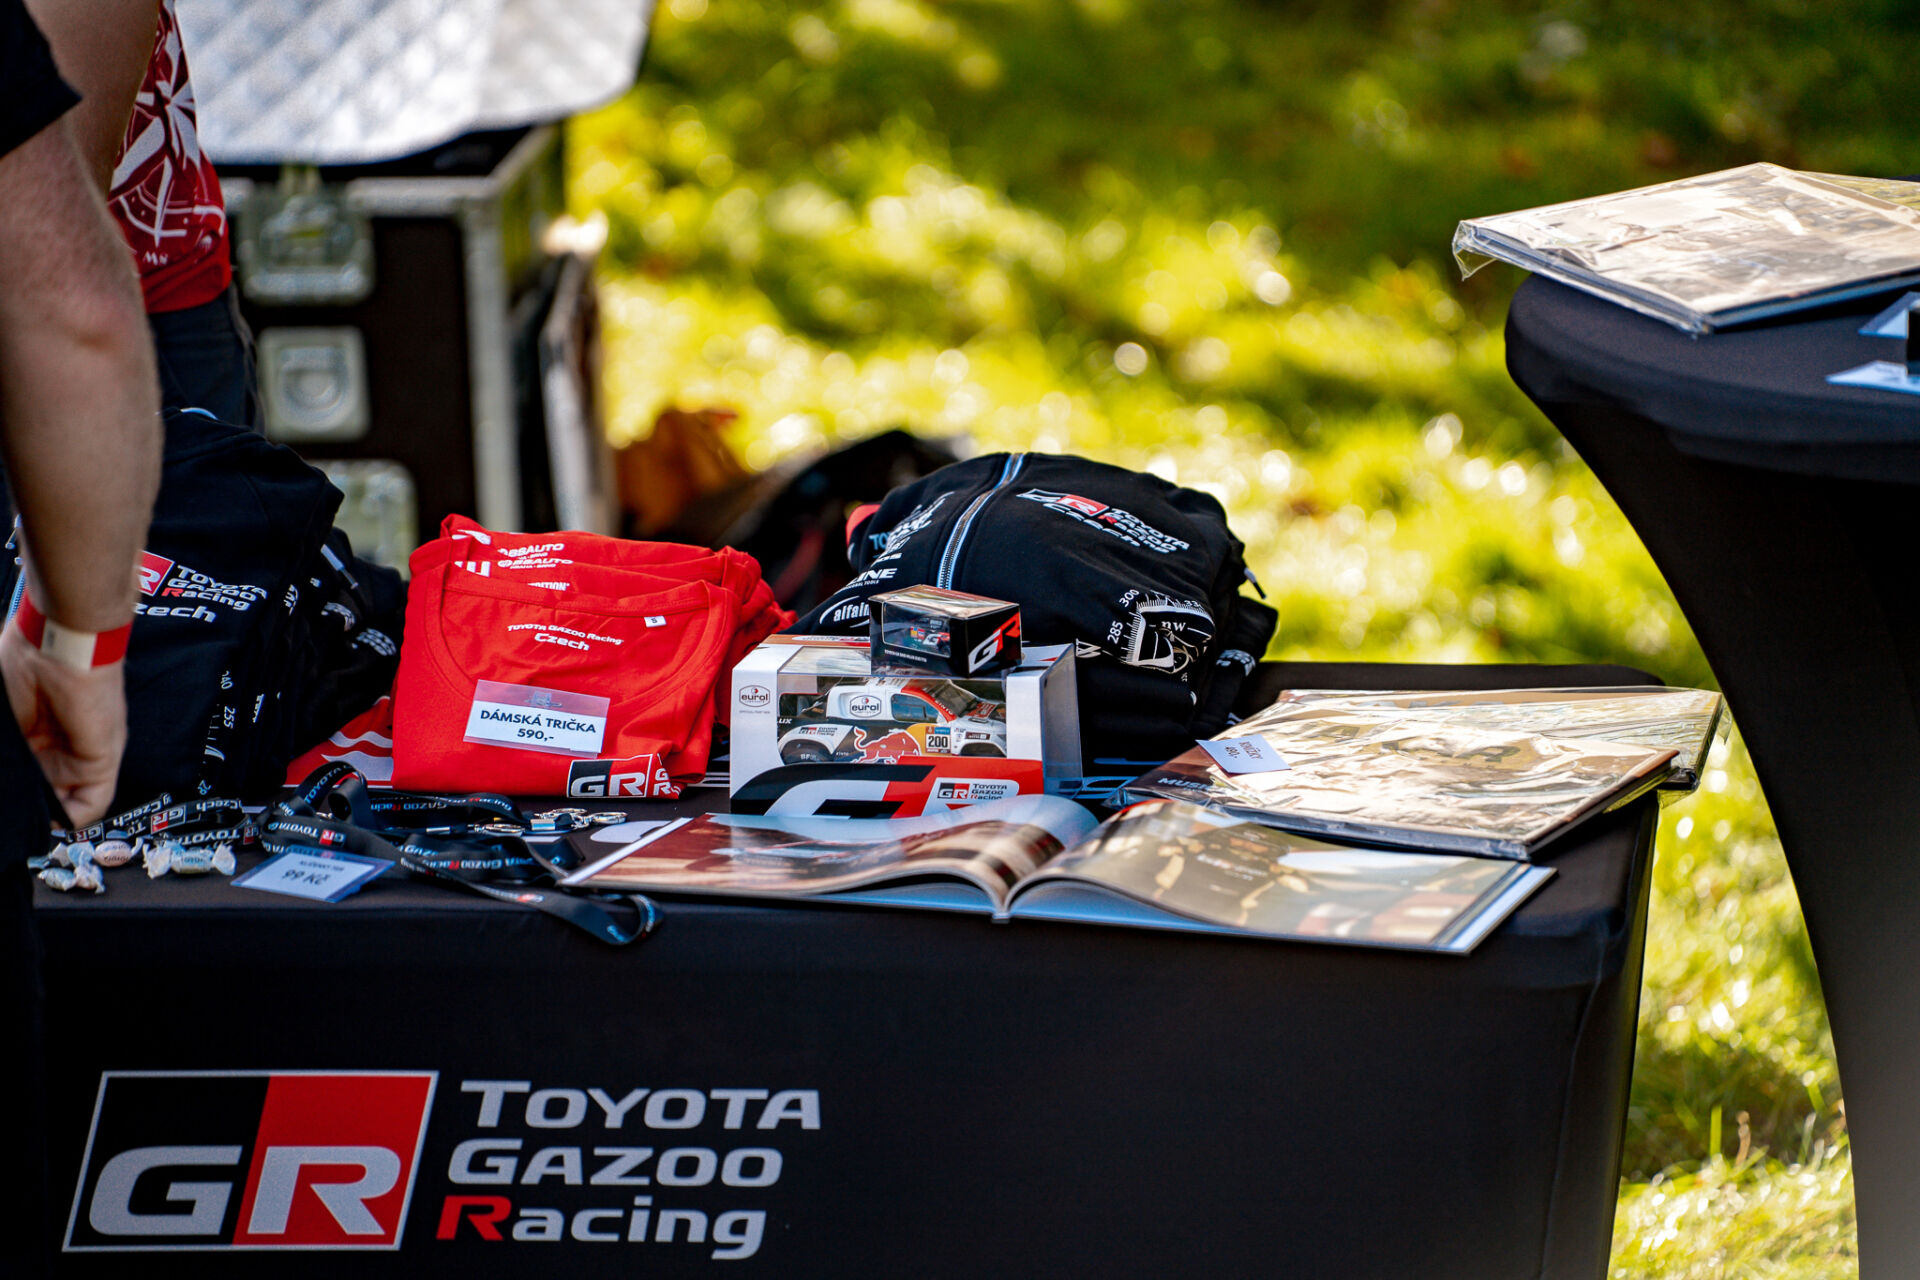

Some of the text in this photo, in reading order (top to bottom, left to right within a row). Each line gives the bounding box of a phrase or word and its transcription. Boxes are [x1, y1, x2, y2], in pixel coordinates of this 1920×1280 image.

[1110, 507, 1190, 550] TOYOTA
[167, 578, 257, 602] GAZOO
[176, 565, 268, 599] TOYOTA
[161, 587, 250, 612] Racing
[1119, 589, 1140, 608] 300
[134, 602, 217, 623] zech
[507, 624, 624, 646] TOYOTA GAZOO Racing
[534, 633, 590, 651] Czech
[1107, 620, 1124, 645] 285
[223, 705, 236, 729] 255
[851, 703, 880, 712] eurol
[480, 708, 597, 734] DÁMSKÁ TRIČKA
[517, 728, 554, 742] 590,-
[928, 735, 949, 748] 200
[570, 771, 646, 797] GR
[938, 788, 970, 799] GR
[113, 800, 162, 827] Czech
[152, 806, 184, 827] GR
[196, 800, 239, 812] Czech
[371, 802, 401, 812] Racin
[461, 1080, 821, 1130] TOYOTA
[448, 1138, 783, 1187] GAZOO
[88, 1145, 403, 1237] GR
[436, 1195, 767, 1260] Racing
